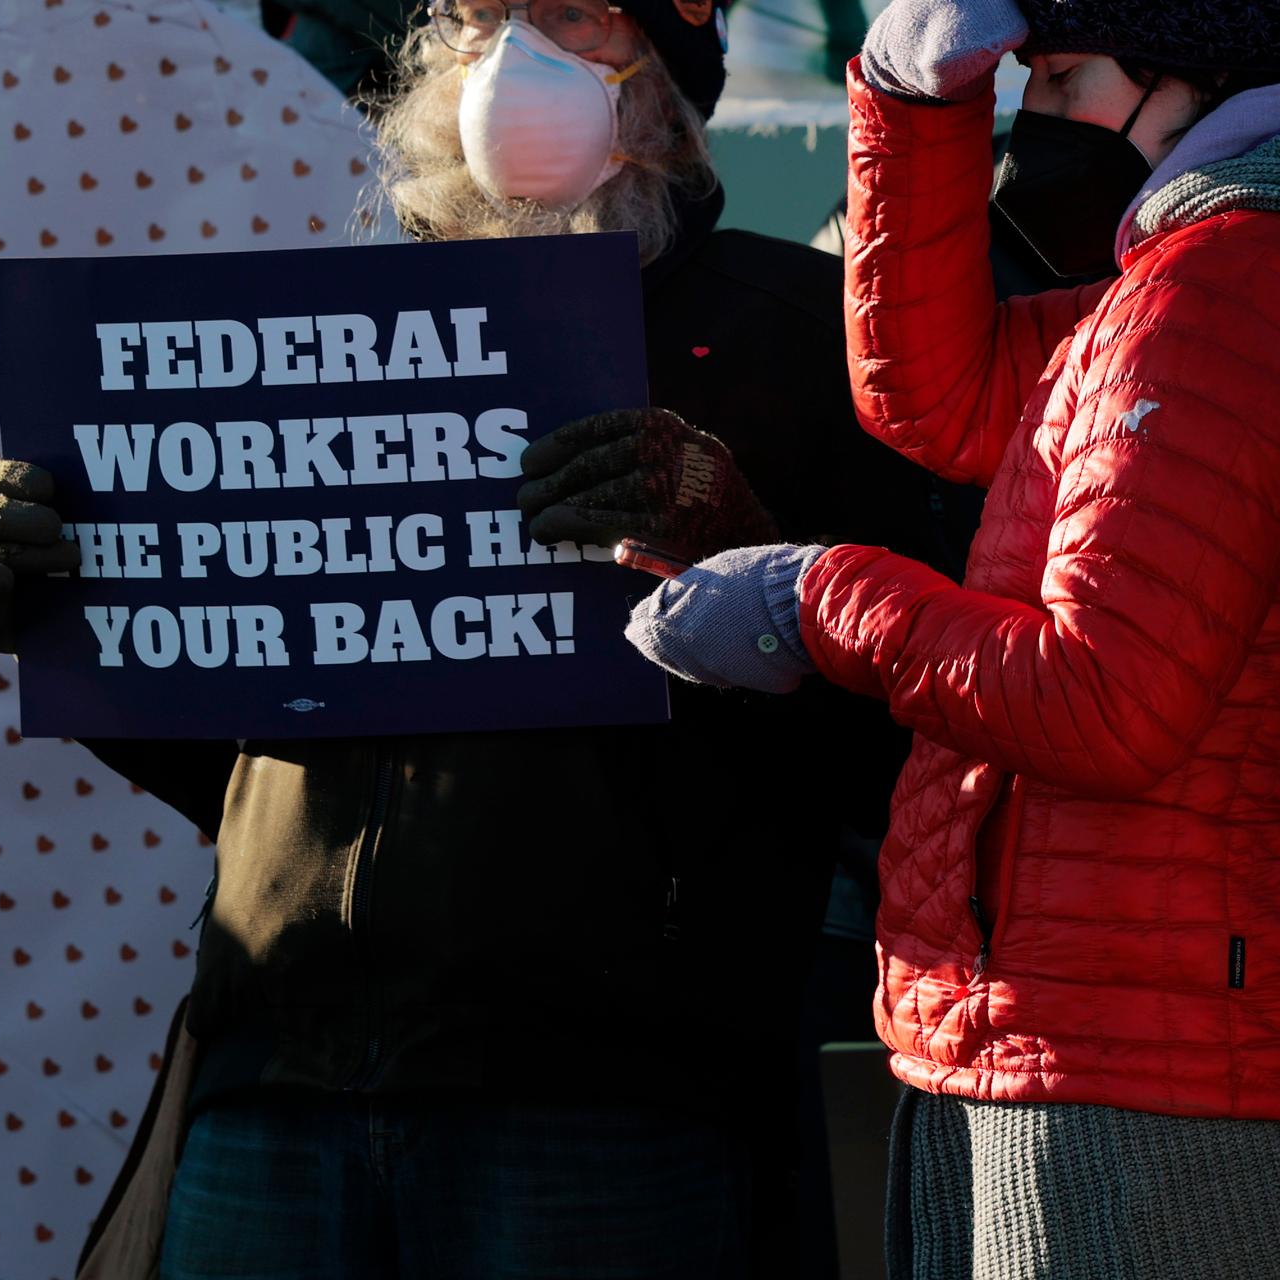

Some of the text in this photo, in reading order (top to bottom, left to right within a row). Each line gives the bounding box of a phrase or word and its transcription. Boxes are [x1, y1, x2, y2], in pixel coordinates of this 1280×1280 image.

[95, 307, 508, 391] FEDERAL
[73, 408, 530, 493] WORKERS
[176, 513, 446, 578] PUBLIC
[84, 591, 576, 668] YOUR BACK!
